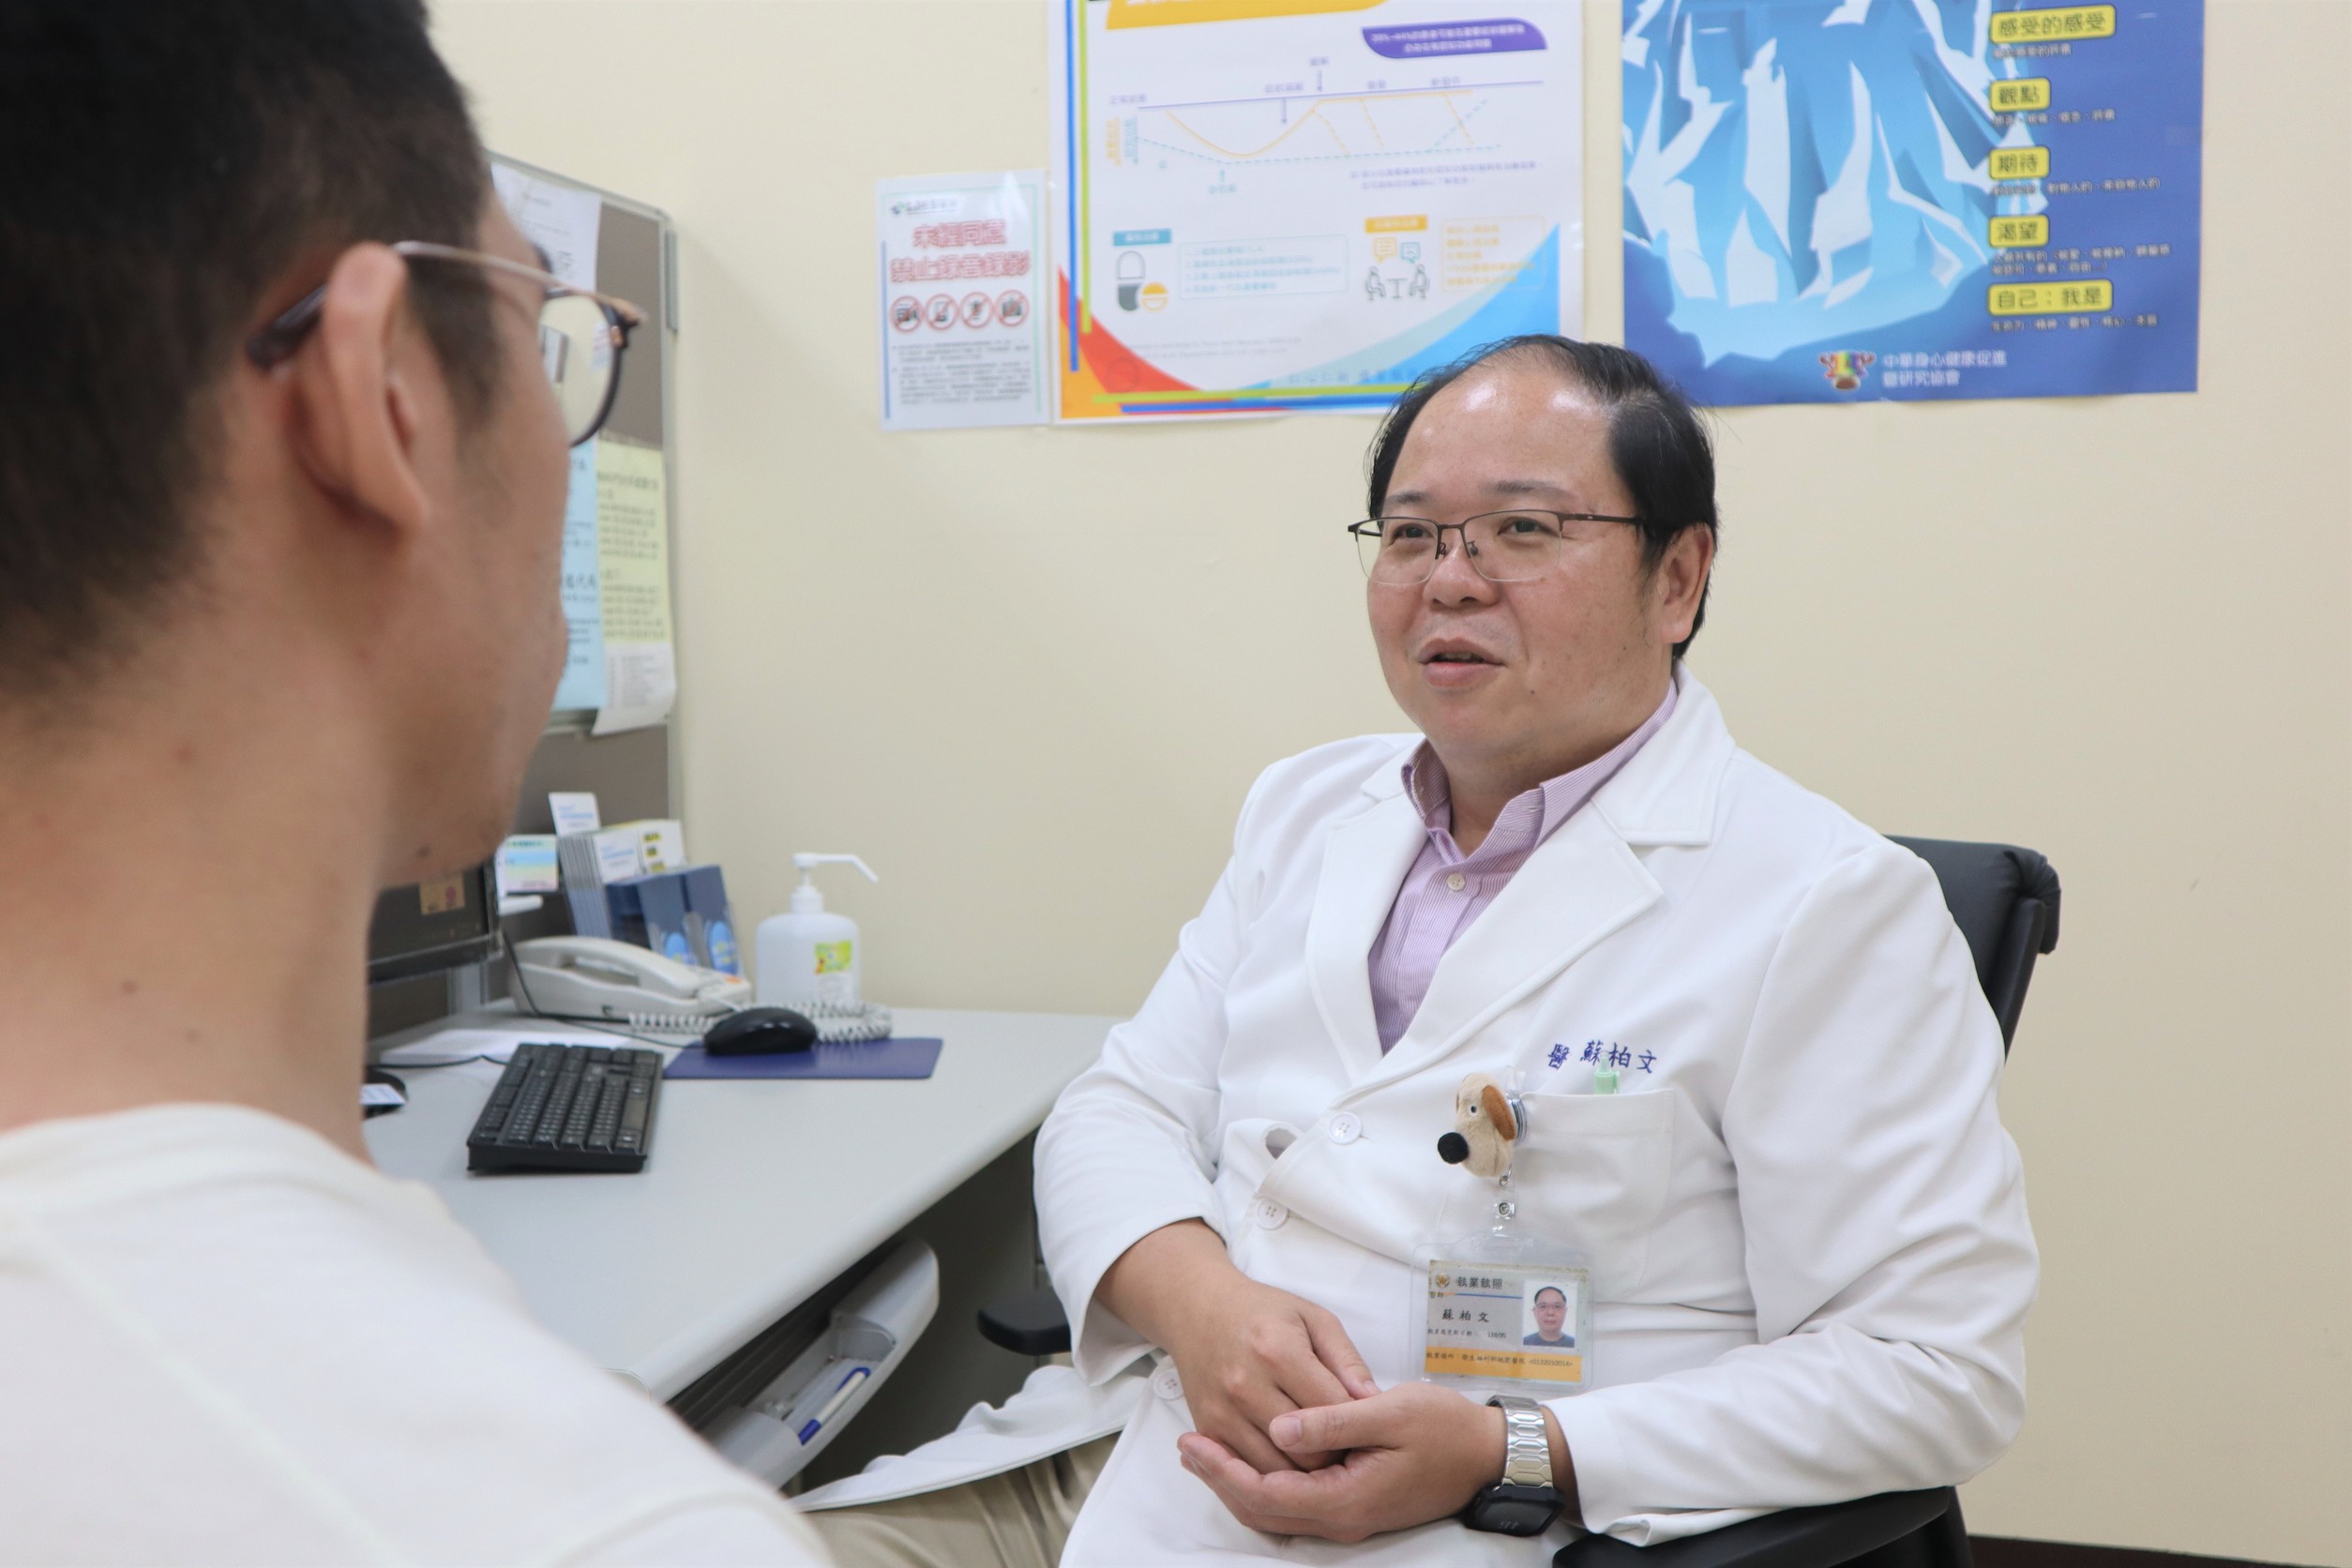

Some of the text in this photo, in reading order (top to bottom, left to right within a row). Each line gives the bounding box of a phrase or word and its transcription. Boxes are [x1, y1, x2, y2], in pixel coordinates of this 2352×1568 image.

[1998, 12, 2105, 37] 感受的感受
[1998, 86, 2041, 104] 觀點
[1998, 154, 2038, 173] 期待
[912, 219, 1007, 249] 未經同意
[1998, 221, 2037, 241] 渴望
[1998, 287, 2103, 308] 自己：我是
[1579, 1039, 1657, 1074] 蘇柏文
[1456, 1276, 1503, 1289] 執業執照
[1441, 1308, 1489, 1323] 蘇柏文
